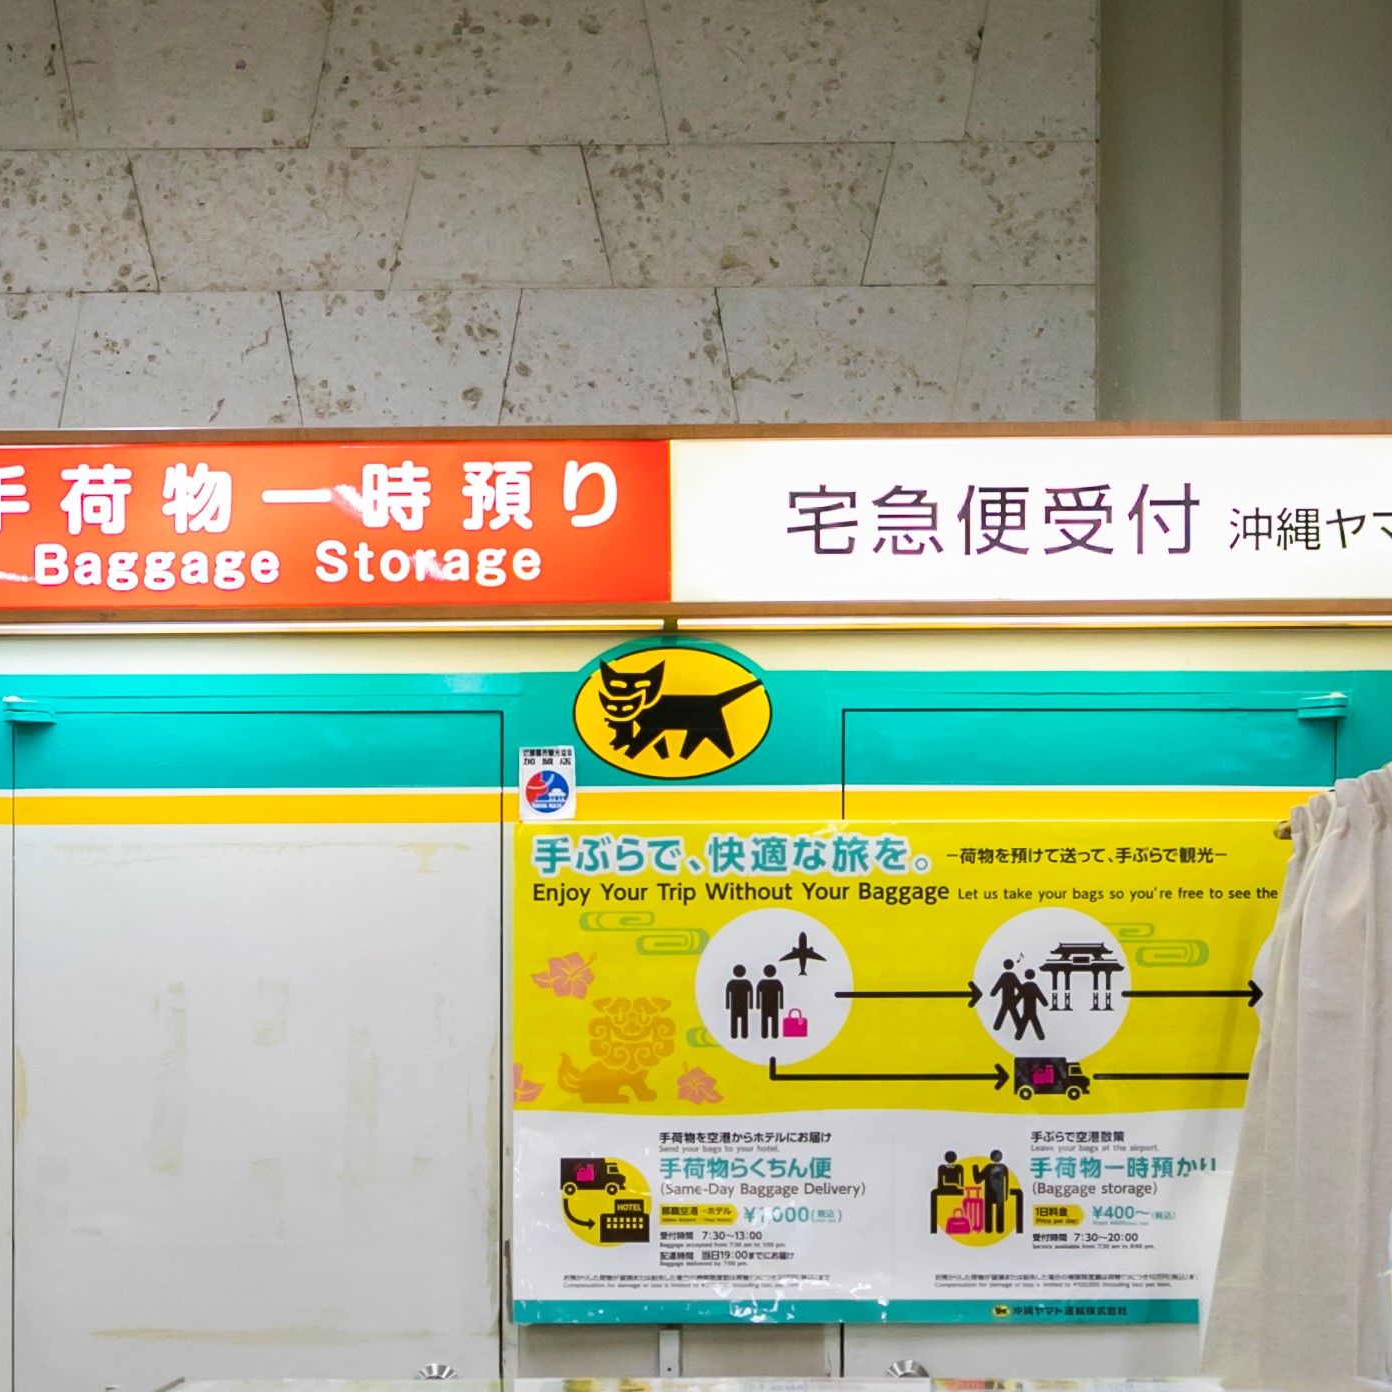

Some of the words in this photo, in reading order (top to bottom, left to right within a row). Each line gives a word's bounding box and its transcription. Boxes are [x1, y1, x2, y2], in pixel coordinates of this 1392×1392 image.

[786, 482, 1201, 557] 宅急便受付
[34, 543, 280, 591] Baggage
[315, 541, 542, 588] Storage
[534, 836, 930, 874] 手ぶらで、快適な旅を。
[533, 884, 591, 906] Enjoy
[601, 884, 648, 901] Your
[657, 884, 696, 905] Trip
[705, 883, 793, 901] Without
[802, 882, 849, 900] Your
[859, 883, 949, 905] Baggage
[958, 888, 978, 899] Let
[984, 889, 999, 899] us
[1004, 888, 1033, 899] take
[1038, 890, 1067, 902] your
[1073, 888, 1104, 903] bags
[1109, 890, 1125, 899] so
[1178, 887, 1204, 899] free
[1209, 889, 1224, 899] to
[1228, 890, 1251, 899] see
[1257, 887, 1278, 899] the
[659, 1132, 832, 1144] 手荷物を空港からホテルにお届け
[1030, 1131, 1125, 1143] 手ぶらで空港散策
[659, 1157, 832, 1179] 手荷物らくちん便
[660, 1183, 735, 1198] (Same-Day
[740, 1182, 799, 1198] Baggage
[804, 1182, 866, 1198] Delivery)
[1032, 1182, 1096, 1197] (Baggage
[1101, 1182, 1158, 1197] storage)
[616, 1203, 642, 1212] HOTEL
